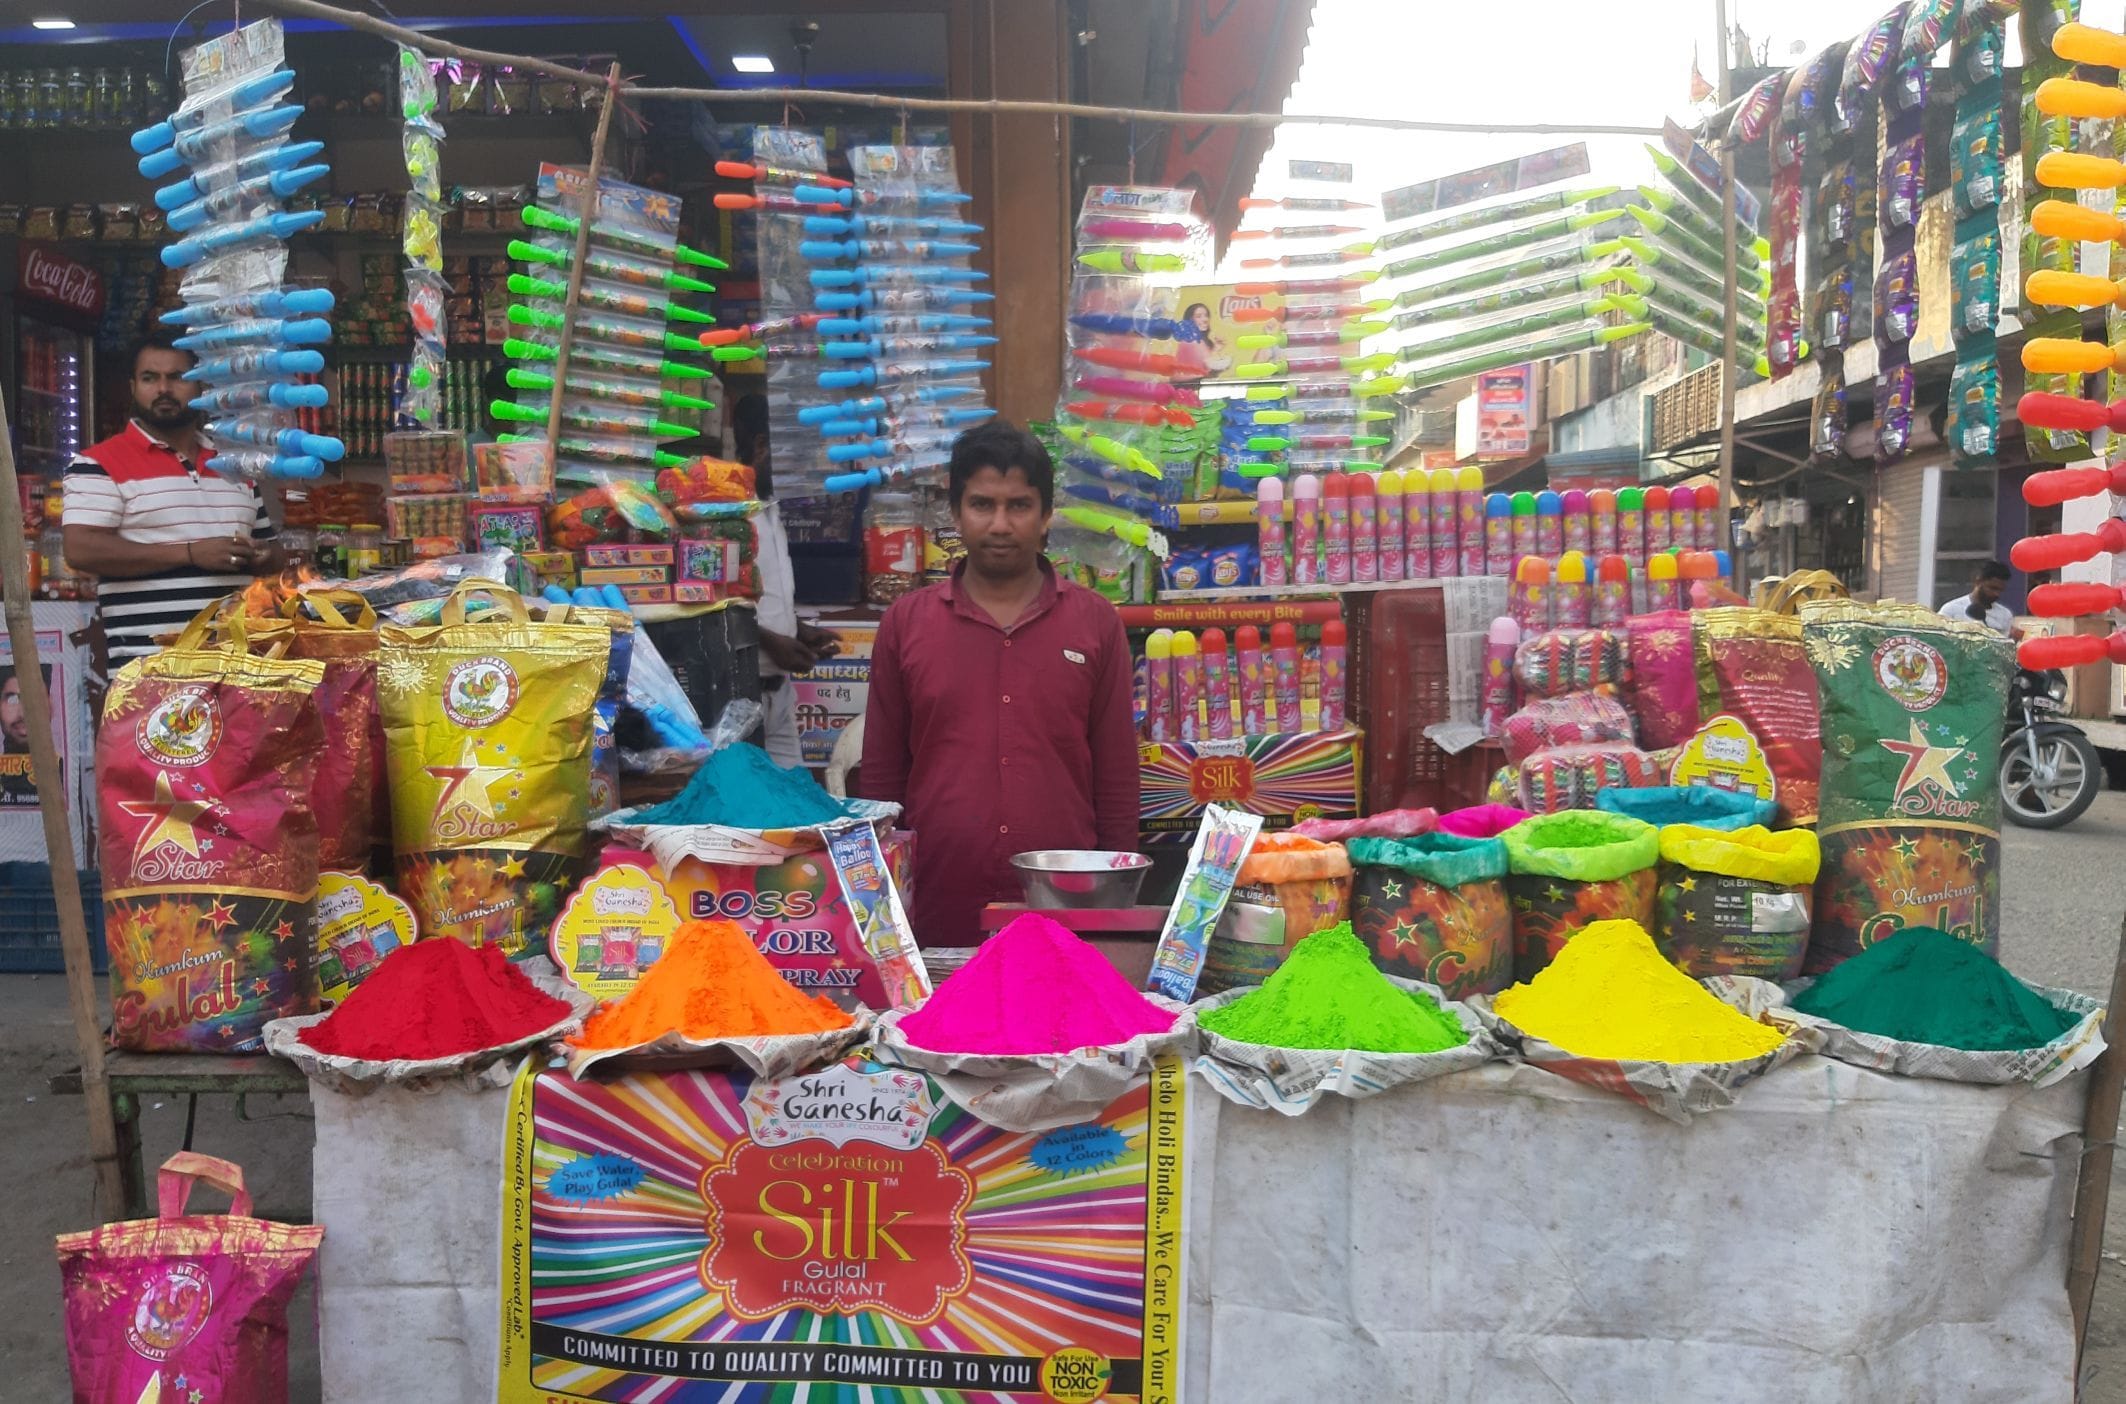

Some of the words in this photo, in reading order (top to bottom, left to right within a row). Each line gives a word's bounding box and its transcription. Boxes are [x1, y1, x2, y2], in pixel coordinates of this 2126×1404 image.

[1154, 607, 1192, 621] Smile
[1195, 607, 1227, 620] with
[1230, 608, 1271, 621] every
[1275, 605, 1303, 619] Bite
[453, 660, 478, 676] DUCK
[482, 658, 511, 676] BRAND
[817, 687, 831, 699] पद
[836, 685, 852, 702] हेतु
[477, 704, 511, 726] PRODUCT
[140, 739, 172, 764] QUALITY
[1202, 766, 1242, 789] Silk
[1902, 778, 1980, 818] Star
[438, 804, 518, 838] Star
[137, 840, 224, 881] Star
[605, 897, 643, 907] Ganesha
[690, 889, 816, 919] BOSS
[1247, 891, 1262, 900] USE
[1892, 881, 1977, 908] Kumkum
[433, 897, 517, 929] Kumkum
[746, 928, 837, 955] LOR
[133, 948, 225, 984] Kumkum
[778, 968, 863, 989] PRAY
[113, 958, 242, 1041] Gulal
[799, 1078, 846, 1098] Shri
[783, 1096, 904, 1123] Ganesha
[1043, 1129, 1110, 1147] Available
[1157, 1111, 1176, 1148] Holi
[513, 1110, 528, 1174] Certified
[1072, 1143, 1085, 1152] in
[769, 1151, 904, 1173] Celebration
[1047, 1156, 1062, 1166] 12
[1065, 1149, 1114, 1164] Colors
[561, 1168, 593, 1181] Save
[512, 1176, 526, 1196] By
[564, 1181, 595, 1195] Play
[597, 1178, 632, 1191] Gulal
[513, 1197, 525, 1234] Govt.
[752, 1178, 917, 1262] Silk
[511, 1238, 524, 1302] Approved
[803, 1260, 867, 1280] Gulal
[781, 1279, 888, 1297] FRAGRANT
[1153, 1264, 1173, 1306] Care
[1152, 1313, 1171, 1343] For
[563, 1336, 678, 1369] COMMITTED
[688, 1350, 715, 1371] TO
[725, 1351, 816, 1373] QUALITY
[823, 1352, 944, 1380] COMMITTED
[953, 1361, 980, 1382] TO
[989, 1363, 1032, 1385] YOU
[1052, 1354, 1069, 1362] Safe
[1055, 1362, 1094, 1376] NON
[1150, 1349, 1170, 1390] Your
[1050, 1376, 1099, 1390] TOXIC
[1053, 1390, 1069, 1398] Non
[1070, 1391, 1095, 1399] Irritant
